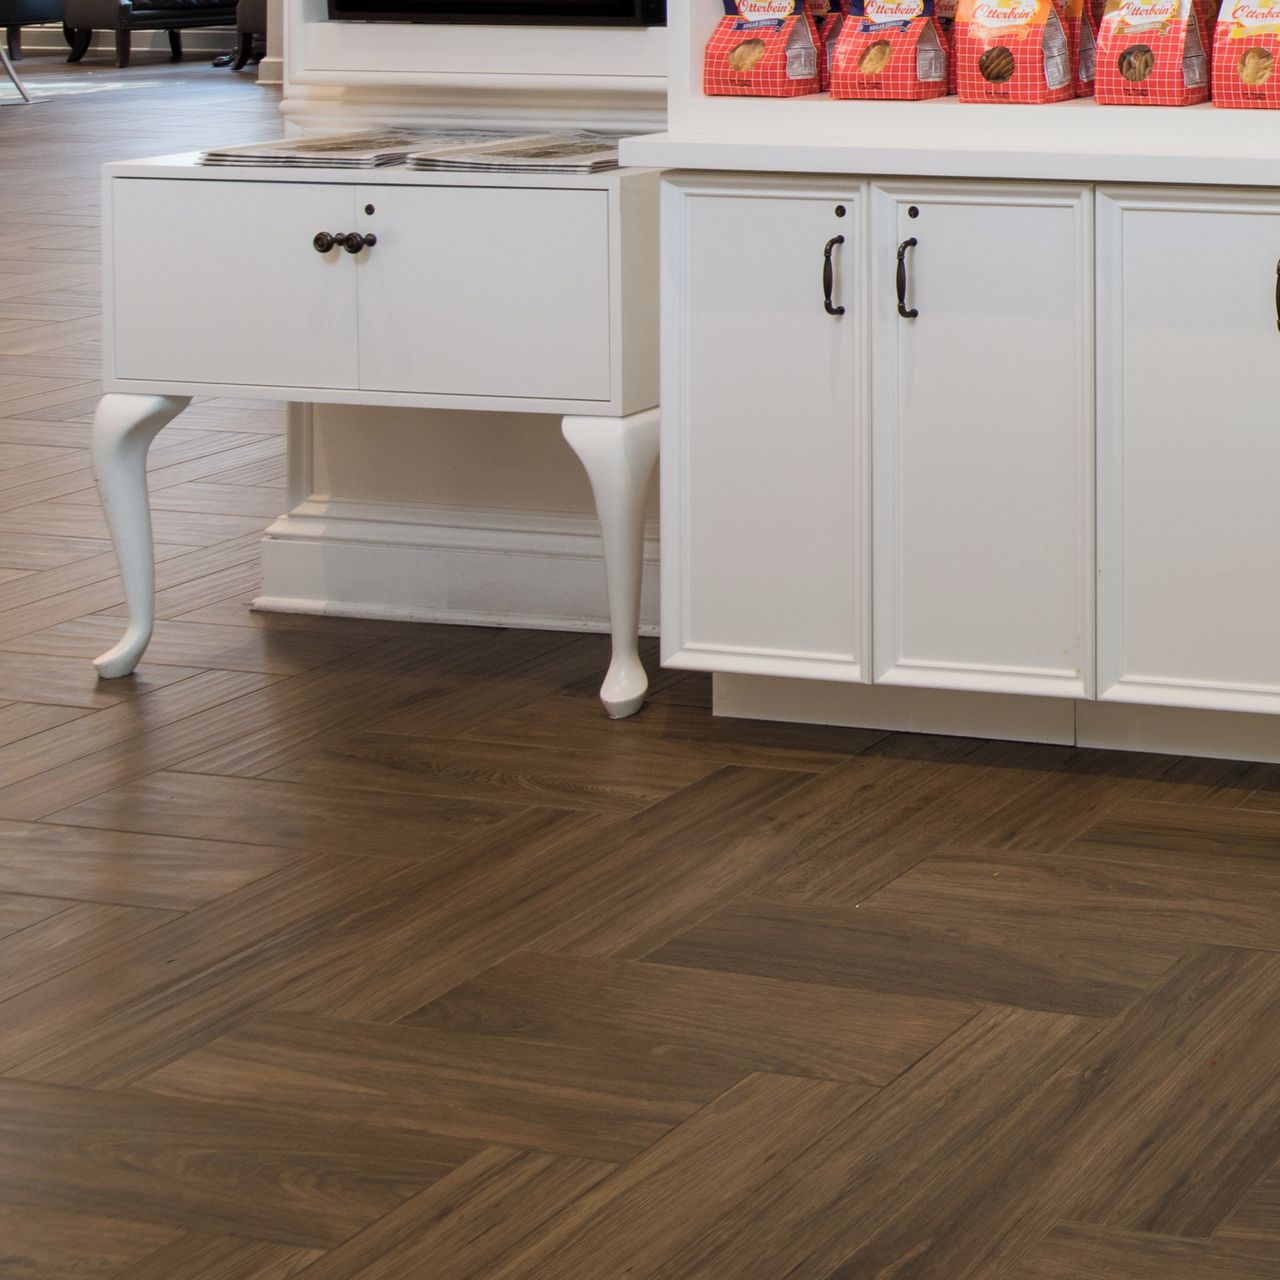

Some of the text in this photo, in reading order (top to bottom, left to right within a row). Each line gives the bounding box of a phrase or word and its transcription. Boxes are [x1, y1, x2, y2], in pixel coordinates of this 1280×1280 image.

[737, 0, 796, 16] Otterbein's
[863, 0, 922, 17] Otterbein's
[971, 2, 1037, 20] Otterbein's
[1119, 1, 1178, 18] Otterbein's
